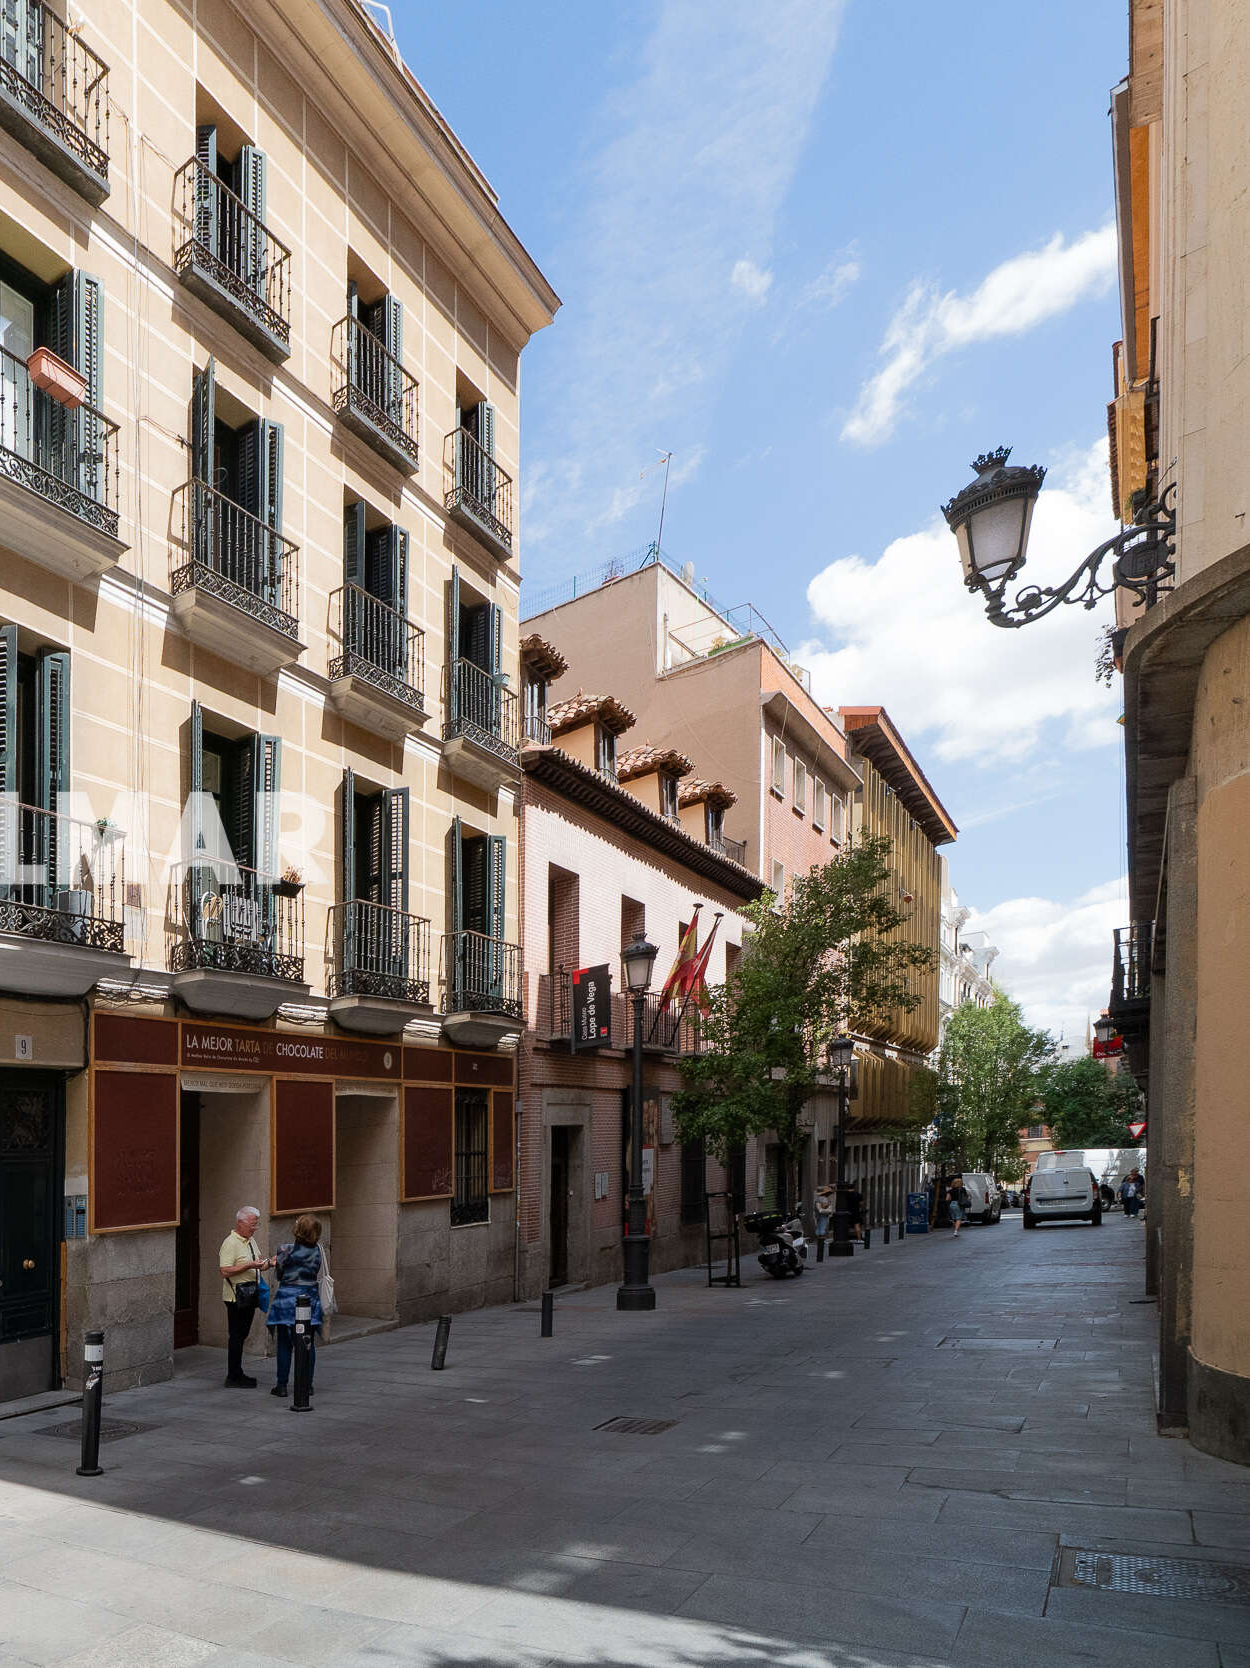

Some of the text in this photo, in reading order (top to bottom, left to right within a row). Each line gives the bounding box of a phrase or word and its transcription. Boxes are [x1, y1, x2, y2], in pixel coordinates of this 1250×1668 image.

[587, 981, 597, 1039] Lope de Vega
[21, 1039, 27, 1055] 9
[186, 1033, 199, 1049] LA
[201, 1035, 233, 1052] MEJOR
[234, 1038, 261, 1055] TARTA
[276, 1042, 324, 1060] CHOCOLATE
